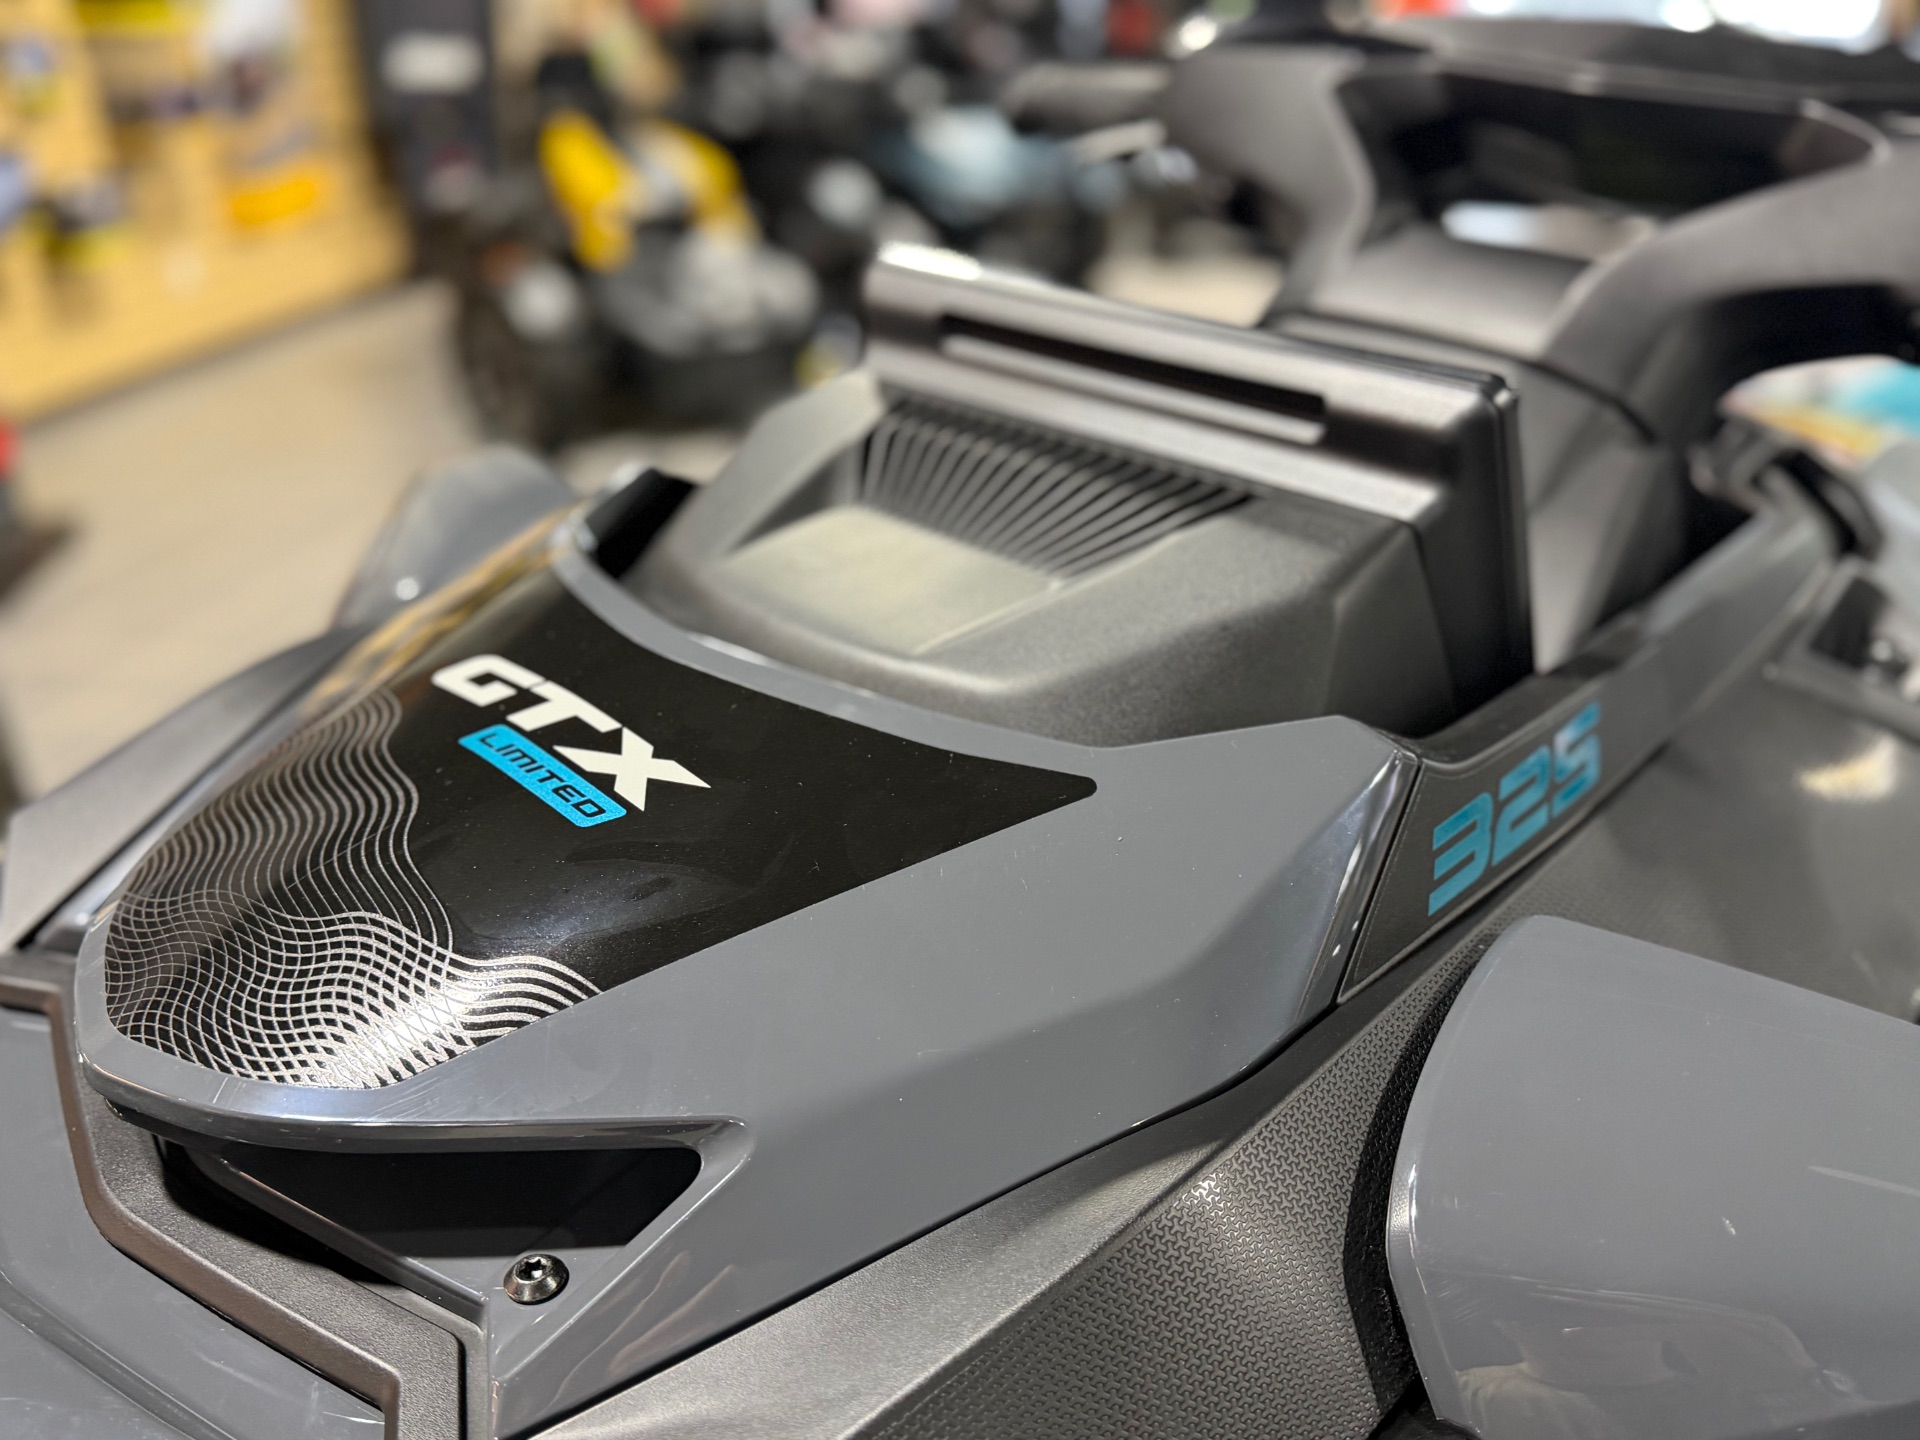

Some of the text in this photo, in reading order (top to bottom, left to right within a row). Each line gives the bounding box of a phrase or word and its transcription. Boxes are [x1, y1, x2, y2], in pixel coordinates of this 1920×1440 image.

[431, 654, 711, 811] GTX
[478, 733, 606, 818] LIMITED
[1428, 702, 1600, 917] 325
